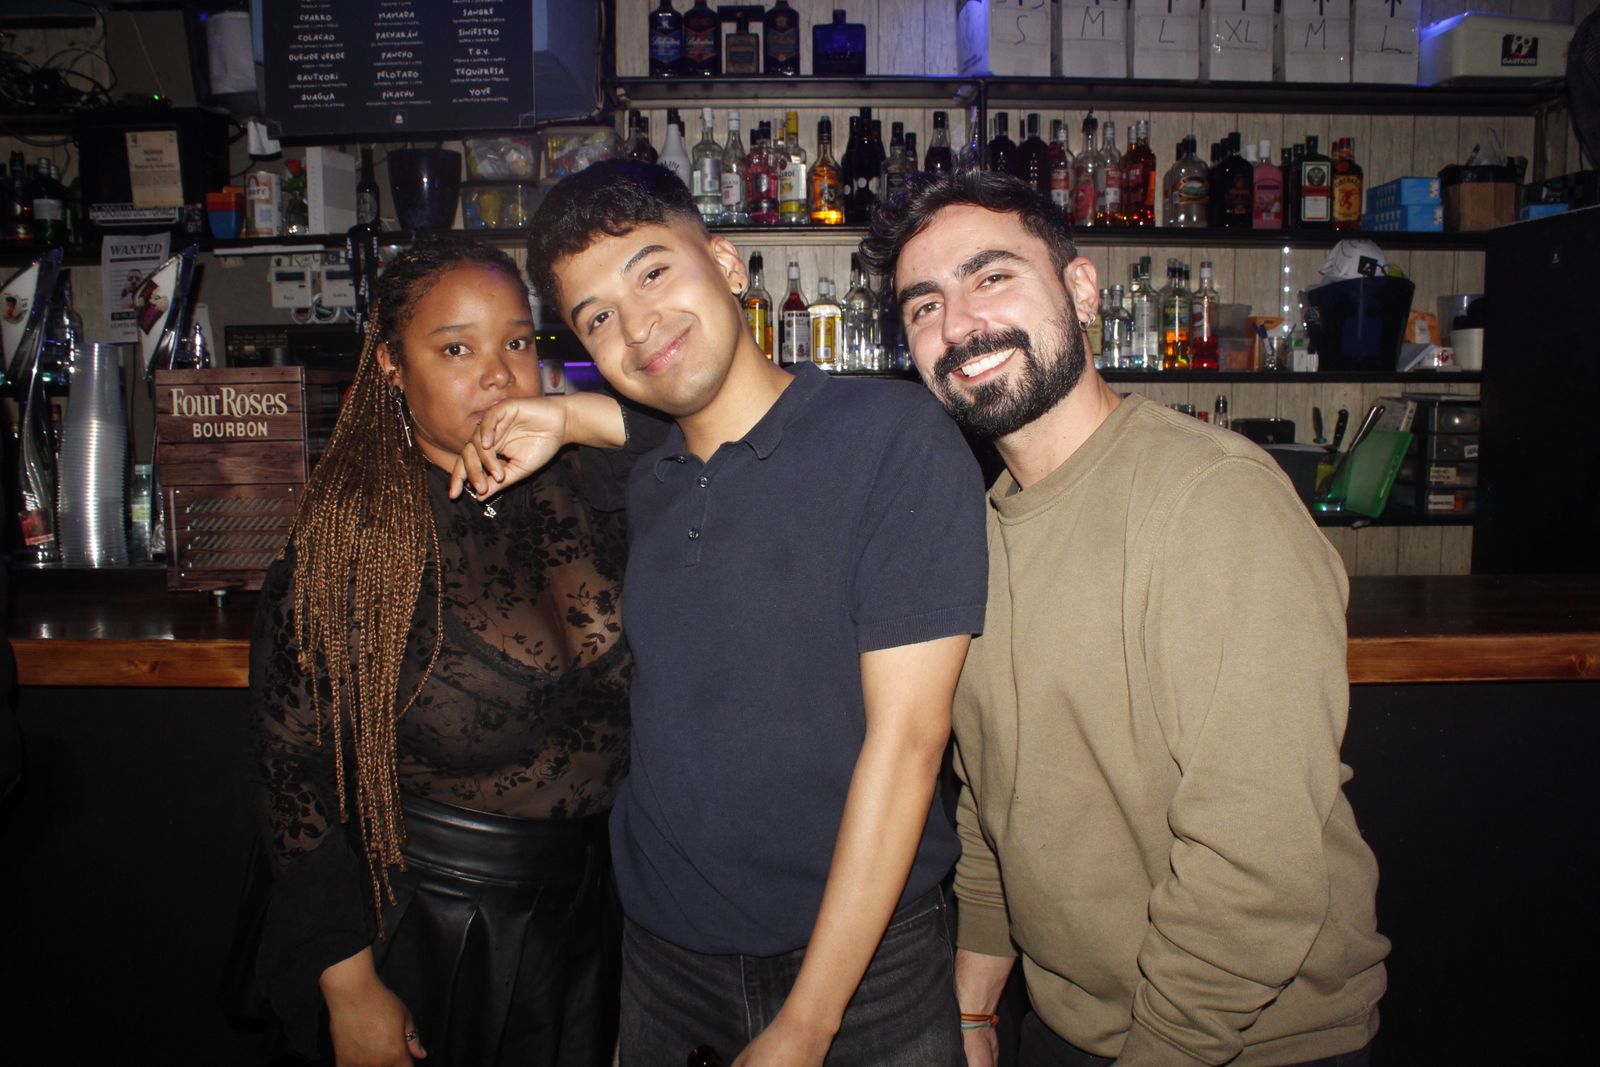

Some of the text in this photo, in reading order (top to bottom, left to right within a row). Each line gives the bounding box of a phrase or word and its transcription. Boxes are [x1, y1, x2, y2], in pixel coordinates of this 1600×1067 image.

[379, 11, 414, 19] MAMADA
[463, 8, 494, 16] SANGRE
[1081, 7, 1105, 37] M
[1014, 15, 1029, 45] S
[1158, 19, 1176, 43] L
[1225, 19, 1258, 44] XL
[1305, 19, 1327, 50] M
[1381, 25, 1404, 53] L
[289, 52, 345, 61] DUENDE VERDE
[382, 51, 413, 60] PANCHO
[377, 70, 419, 80] PELOTAZO
[110, 243, 162, 256] WANTED
[170, 387, 289, 418] Four Roses
[193, 421, 268, 438] BOURBON
